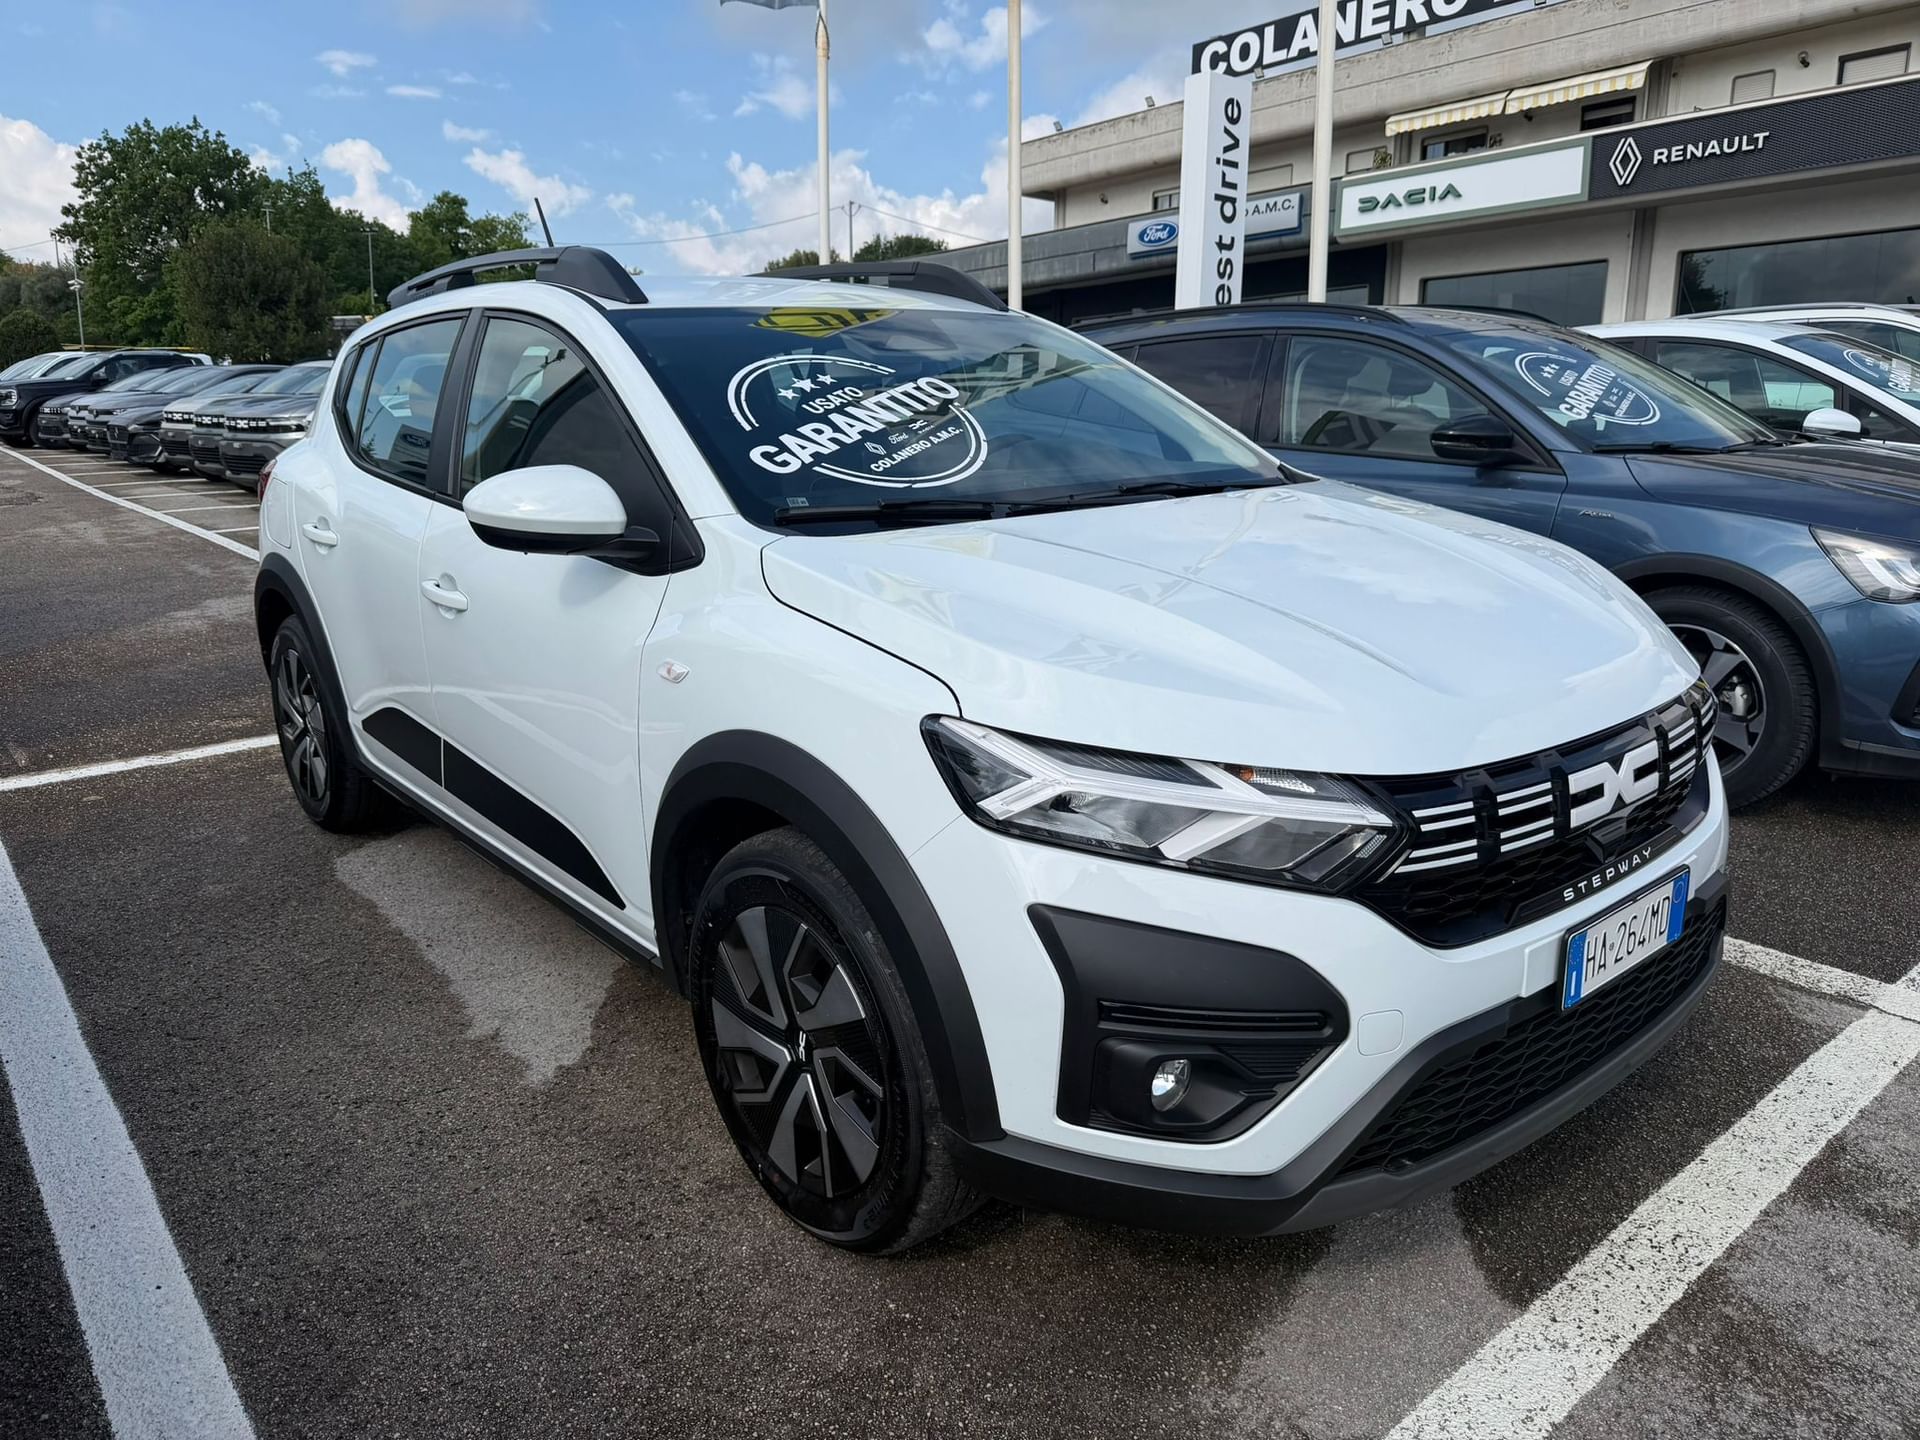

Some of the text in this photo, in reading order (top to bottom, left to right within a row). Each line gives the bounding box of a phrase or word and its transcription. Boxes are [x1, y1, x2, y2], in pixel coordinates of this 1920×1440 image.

[1214, 97, 1242, 224] drive
[1652, 131, 1770, 165] RENAULT
[1252, 198, 1295, 217] A.M.C.
[1358, 182, 1463, 214] DACIA
[1143, 224, 1170, 242] Ford
[802, 387, 864, 414] USATO
[1558, 364, 1617, 419] GARANTITO
[749, 376, 960, 474] GARANTITO
[870, 426, 964, 472] COLANERO A.M.C.
[1563, 846, 1651, 902] STEPWAY
